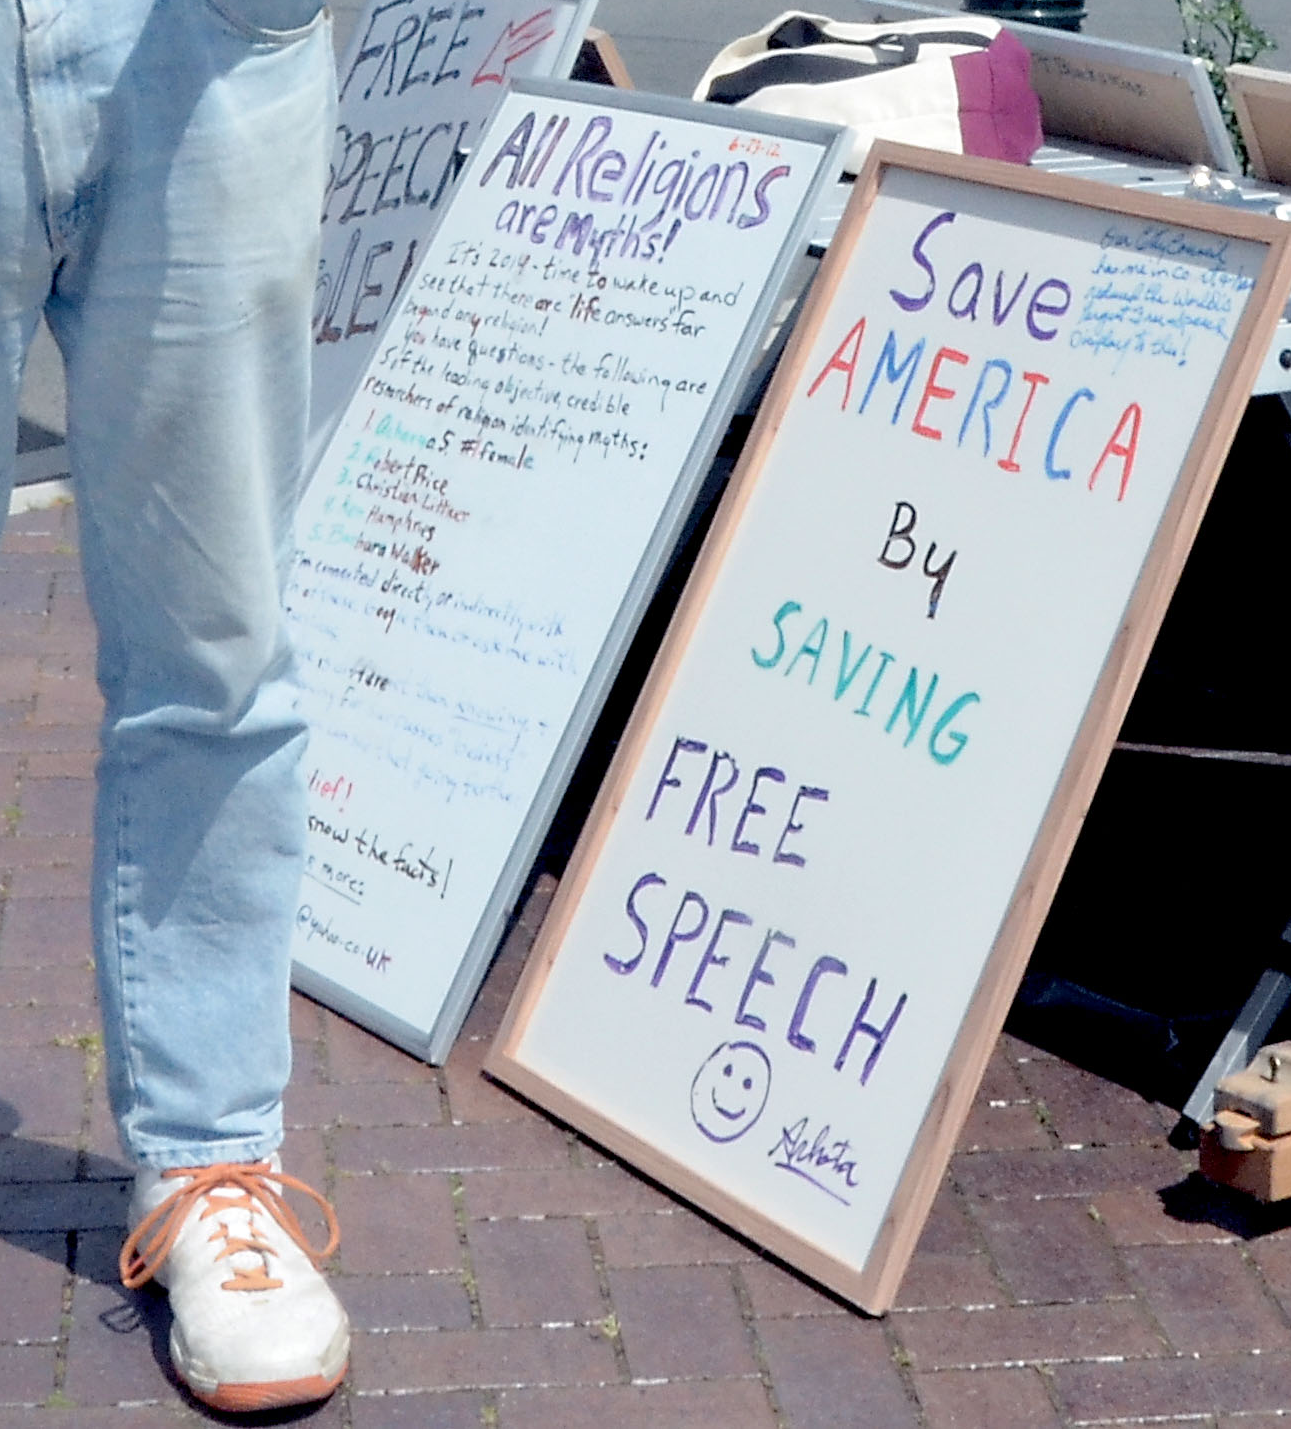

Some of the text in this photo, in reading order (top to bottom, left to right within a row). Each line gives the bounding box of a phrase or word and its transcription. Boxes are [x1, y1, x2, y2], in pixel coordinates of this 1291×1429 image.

[480, 111, 791, 232] All Religions
[495, 200, 558, 244] are
[418, 273, 443, 292] see
[448, 274, 490, 298] that
[492, 279, 533, 308] there
[534, 297, 562, 313] are
[542, 255, 580, 283] time
[586, 270, 607, 290] to
[612, 274, 659, 296] wake
[664, 286, 696, 312] up
[699, 281, 745, 307] and
[890, 212, 1072, 341] Save
[411, 353, 434, 377] the
[566, 390, 631, 416] credible
[432, 326, 461, 351] have
[467, 338, 546, 371] questions
[561, 352, 587, 376] the
[593, 352, 671, 413] following
[675, 379, 708, 395] are
[807, 316, 1143, 501] AMERICA
[436, 395, 460, 414] of
[457, 405, 507, 437] religion
[480, 441, 536, 470] female
[877, 501, 958, 619] By
[751, 601, 981, 765] SAVING
[645, 736, 829, 868] FREE
[354, 828, 389, 866] the
[393, 842, 453, 900] facts!
[603, 873, 908, 1086] SPEECH
